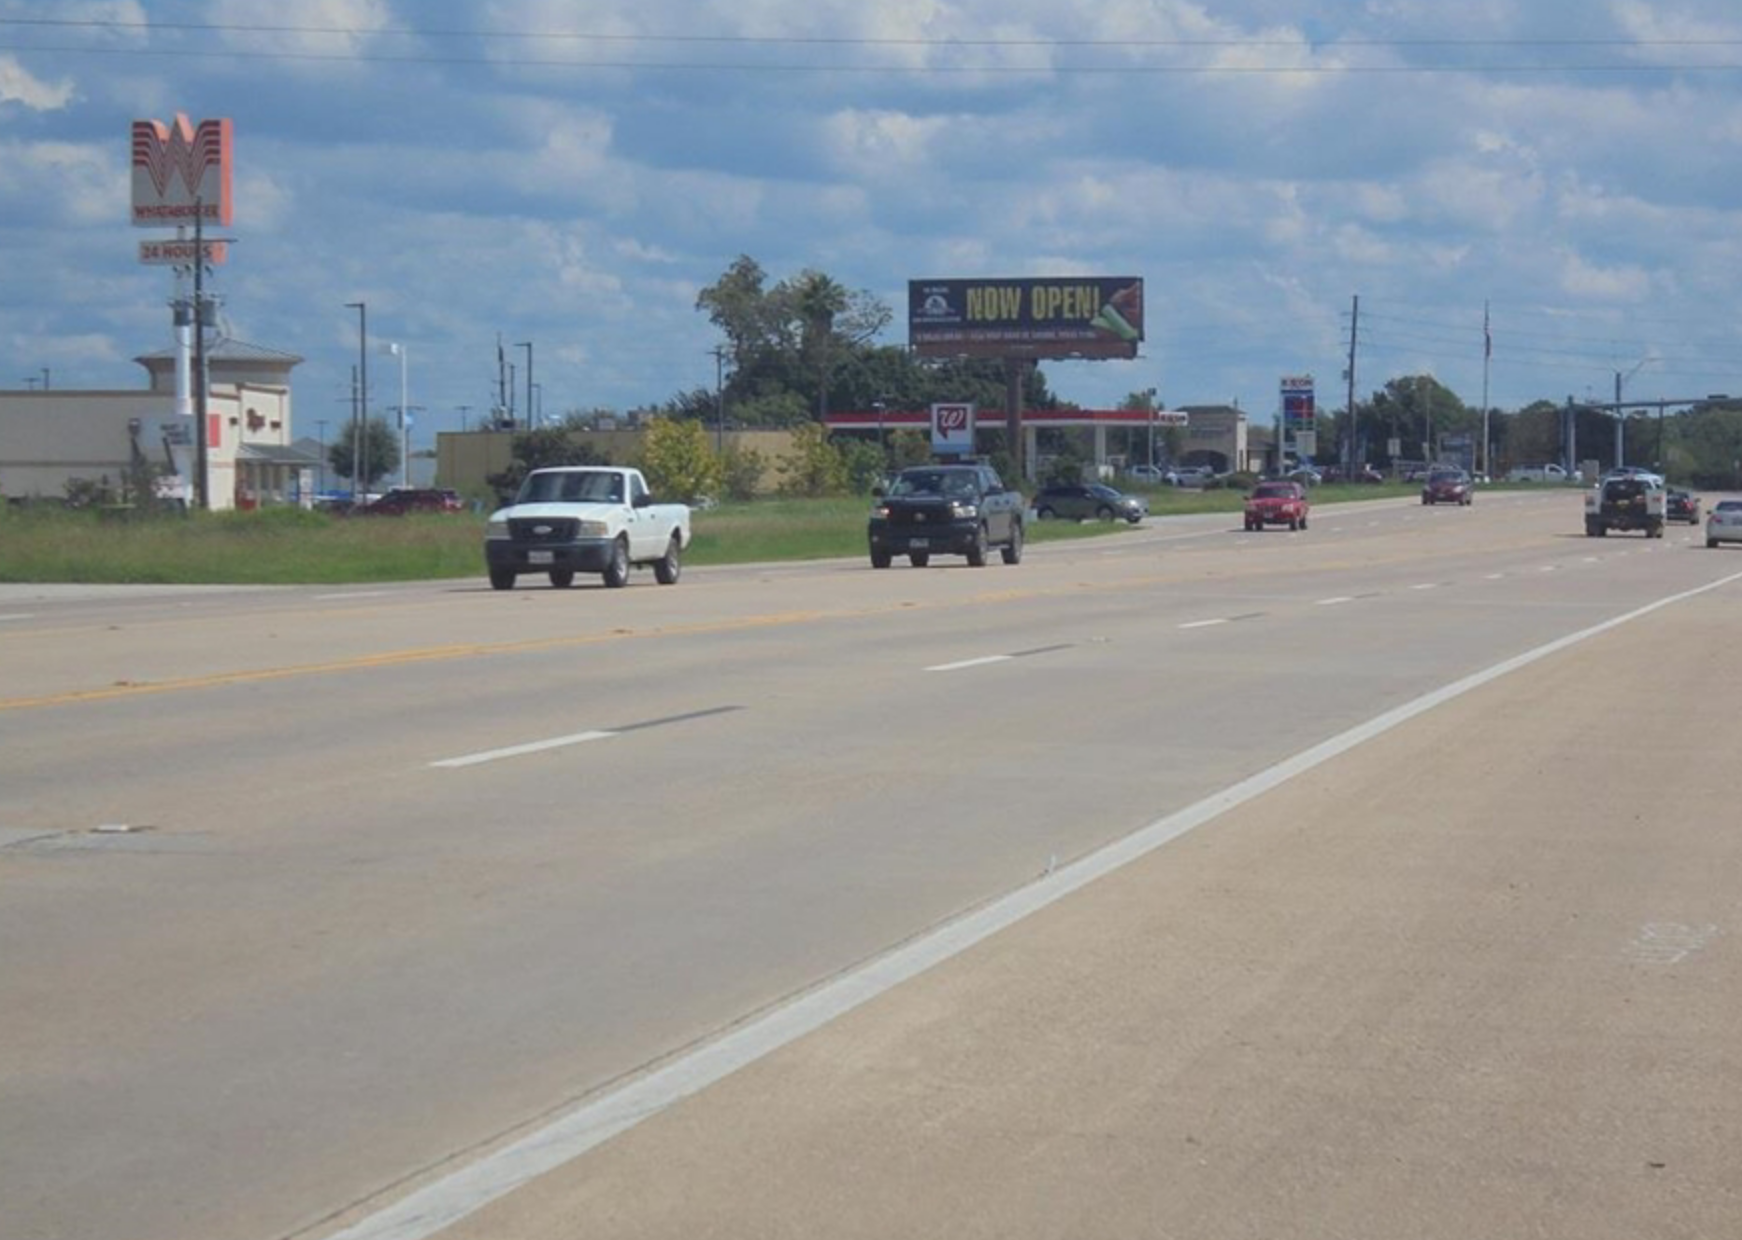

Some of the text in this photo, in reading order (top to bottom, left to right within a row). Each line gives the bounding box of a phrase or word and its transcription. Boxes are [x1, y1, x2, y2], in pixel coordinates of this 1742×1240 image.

[142, 245, 212, 258] 24 HOUS
[966, 285, 1100, 320] NOW OPEN!
